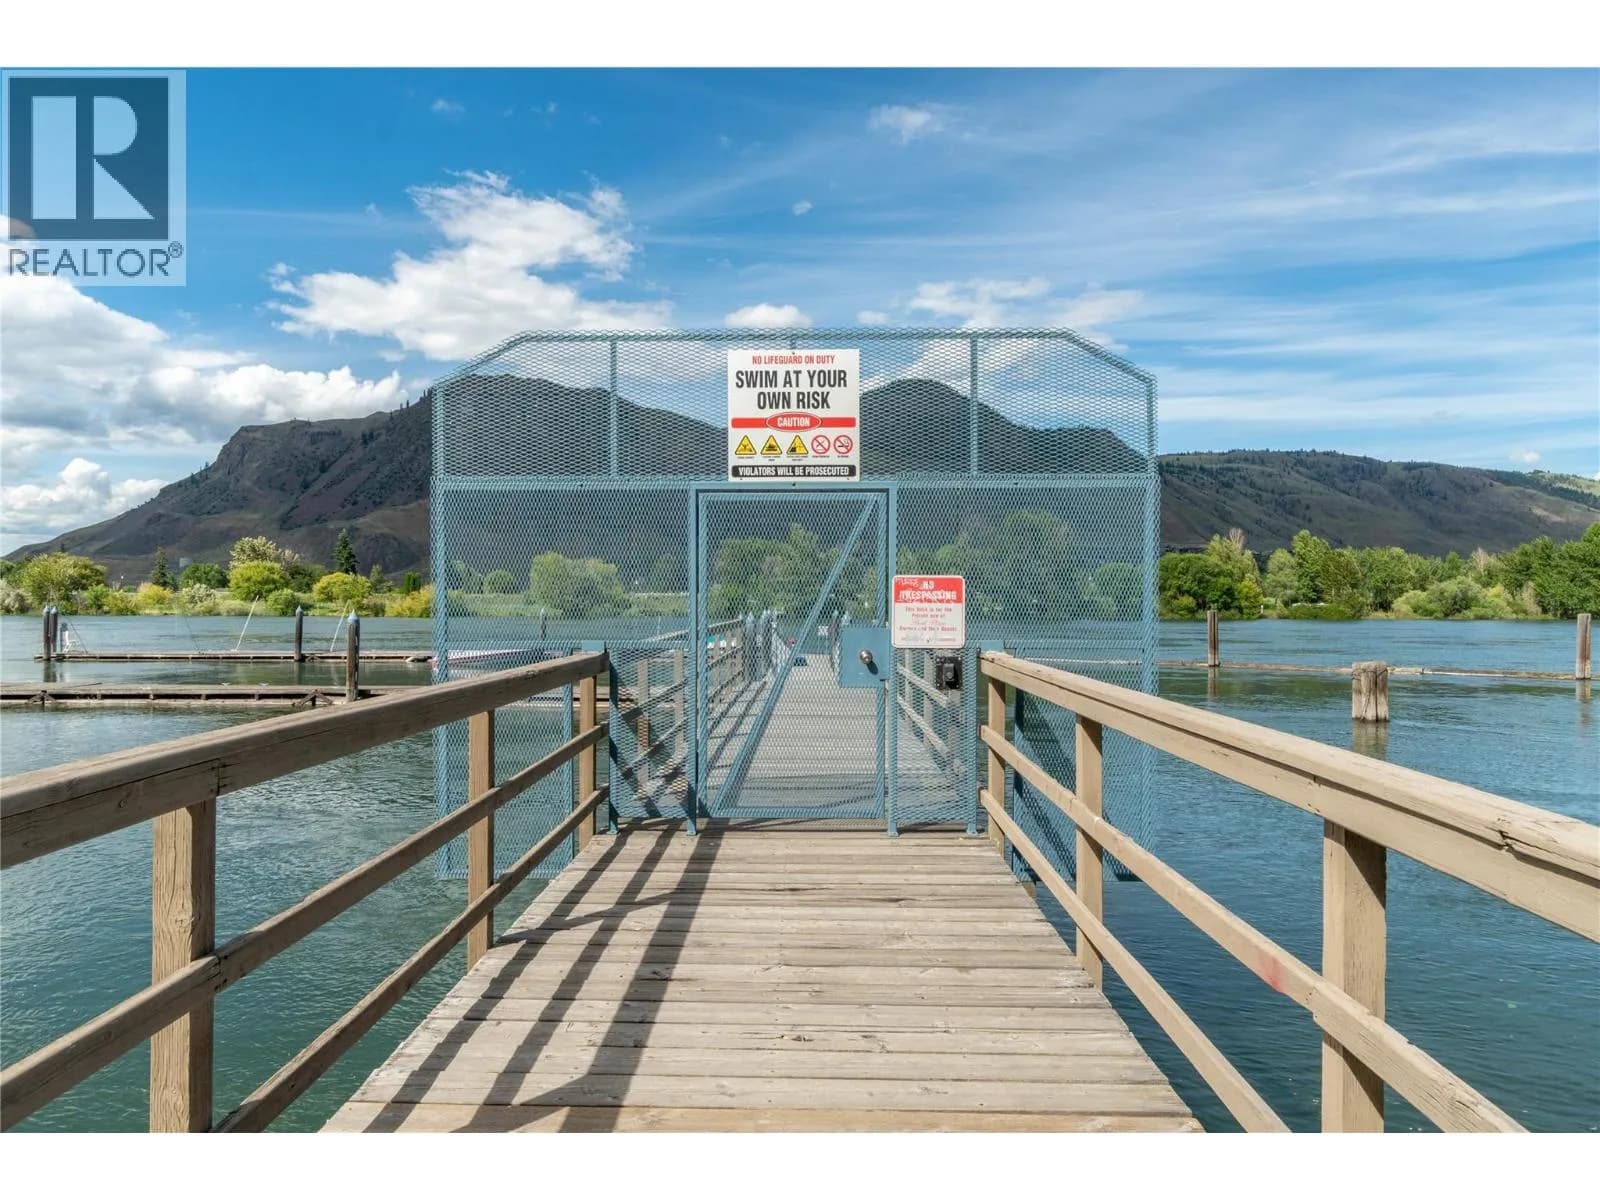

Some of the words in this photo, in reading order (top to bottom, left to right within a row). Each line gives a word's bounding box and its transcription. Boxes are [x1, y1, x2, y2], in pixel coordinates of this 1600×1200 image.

[752, 356, 762, 365] NO
[764, 355, 802, 365] LIFEGUARD
[804, 355, 814, 364] ON
[816, 355, 835, 364] DUTY
[735, 370, 778, 388] SWIM
[783, 370, 802, 388] AT
[807, 370, 847, 388] YOUR
[757, 391, 791, 409] OWN
[796, 391, 830, 409] RISK
[777, 417, 811, 427] CAUTION
[738, 467, 776, 476] VIOLATORS
[777, 467, 793, 476] WILL
[795, 467, 804, 475] BE
[805, 466, 849, 475] PROSECUTED
